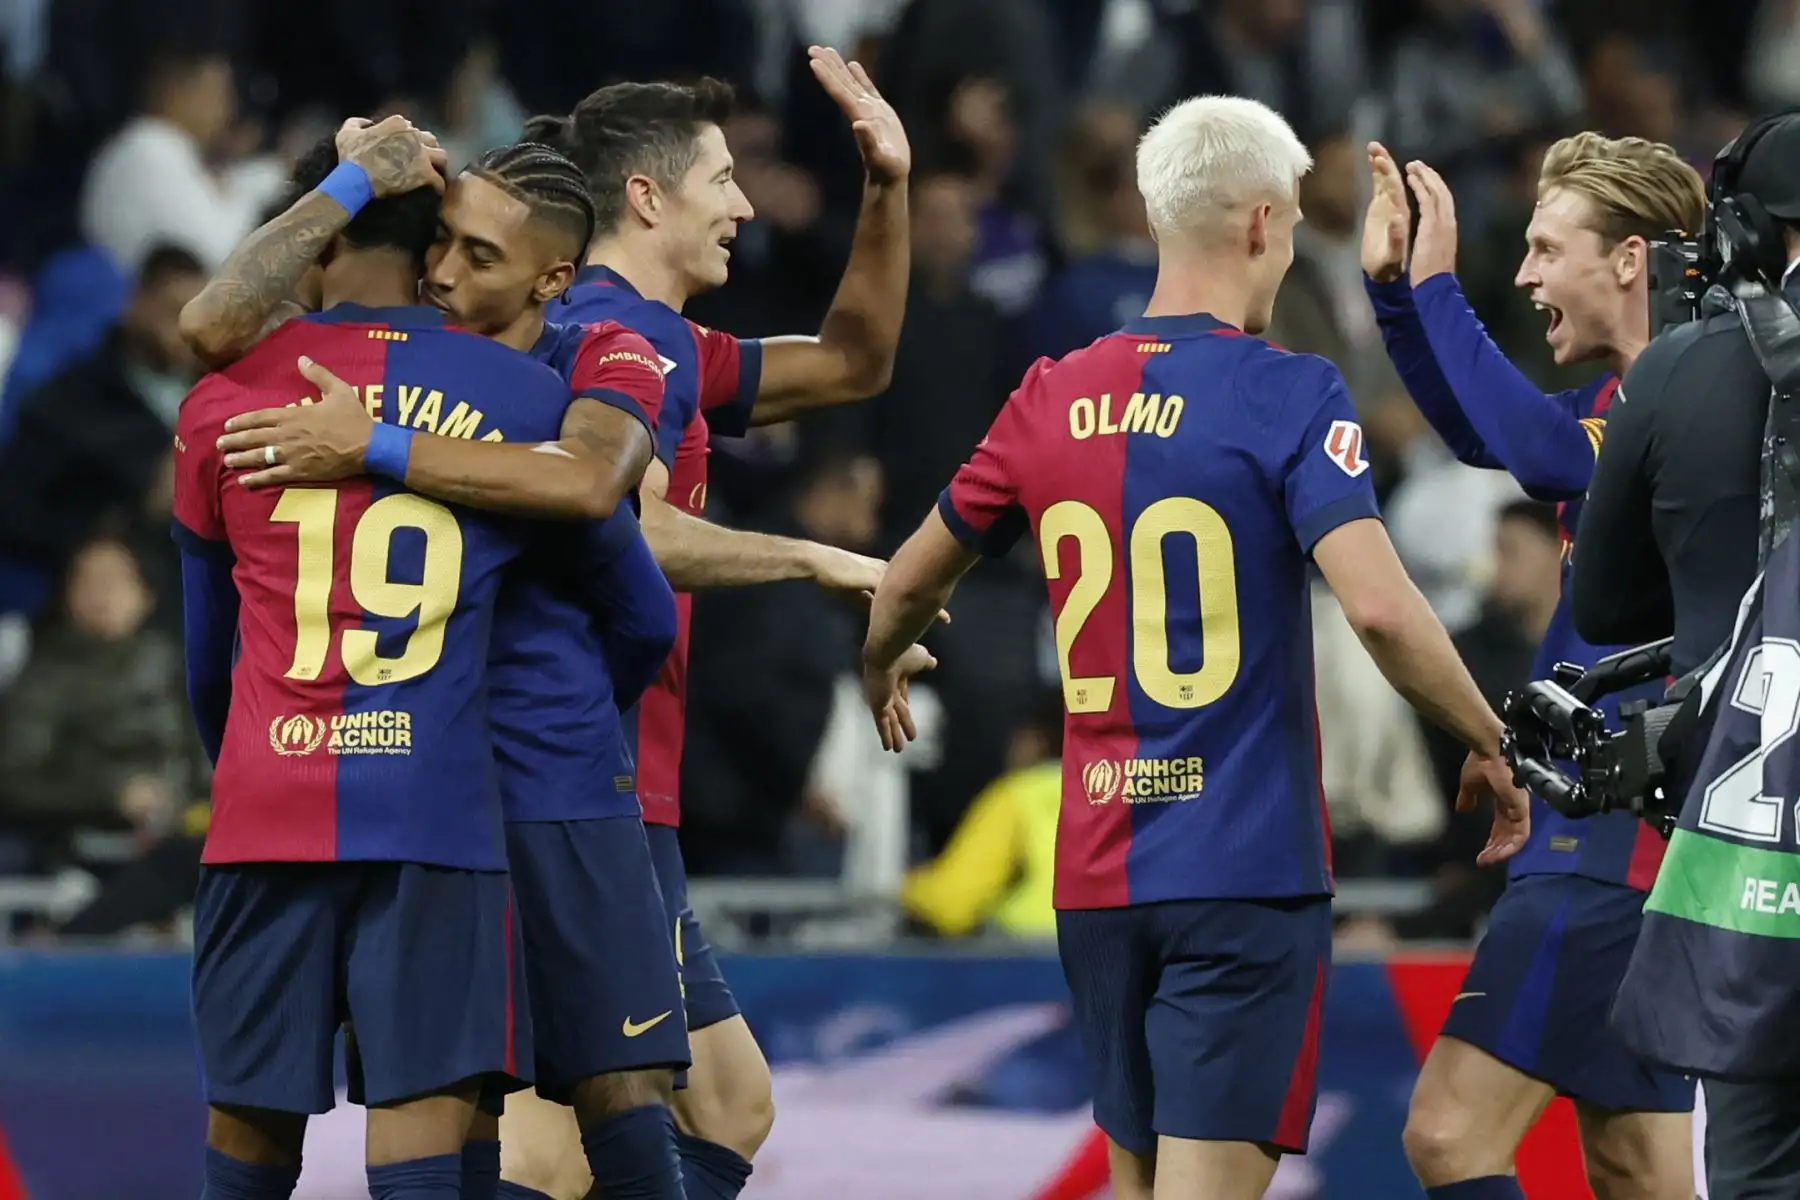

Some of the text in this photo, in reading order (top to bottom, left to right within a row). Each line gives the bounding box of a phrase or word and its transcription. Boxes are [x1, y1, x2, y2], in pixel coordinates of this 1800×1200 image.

[398, 385, 504, 443] YAM
[1069, 393, 1184, 439] OLMO
[269, 488, 463, 686] 19
[1040, 496, 1240, 714] 20
[330, 710, 411, 730] UNHCR
[327, 729, 411, 747] ACNUR
[1698, 636, 1800, 845] 2
[354, 747, 383, 755] Refugee
[384, 747, 411, 756] Agency
[1124, 757, 1203, 777] UNHCR
[1121, 774, 1203, 796] ACNUR
[1121, 796, 1134, 804] The
[1135, 796, 1147, 804] UN
